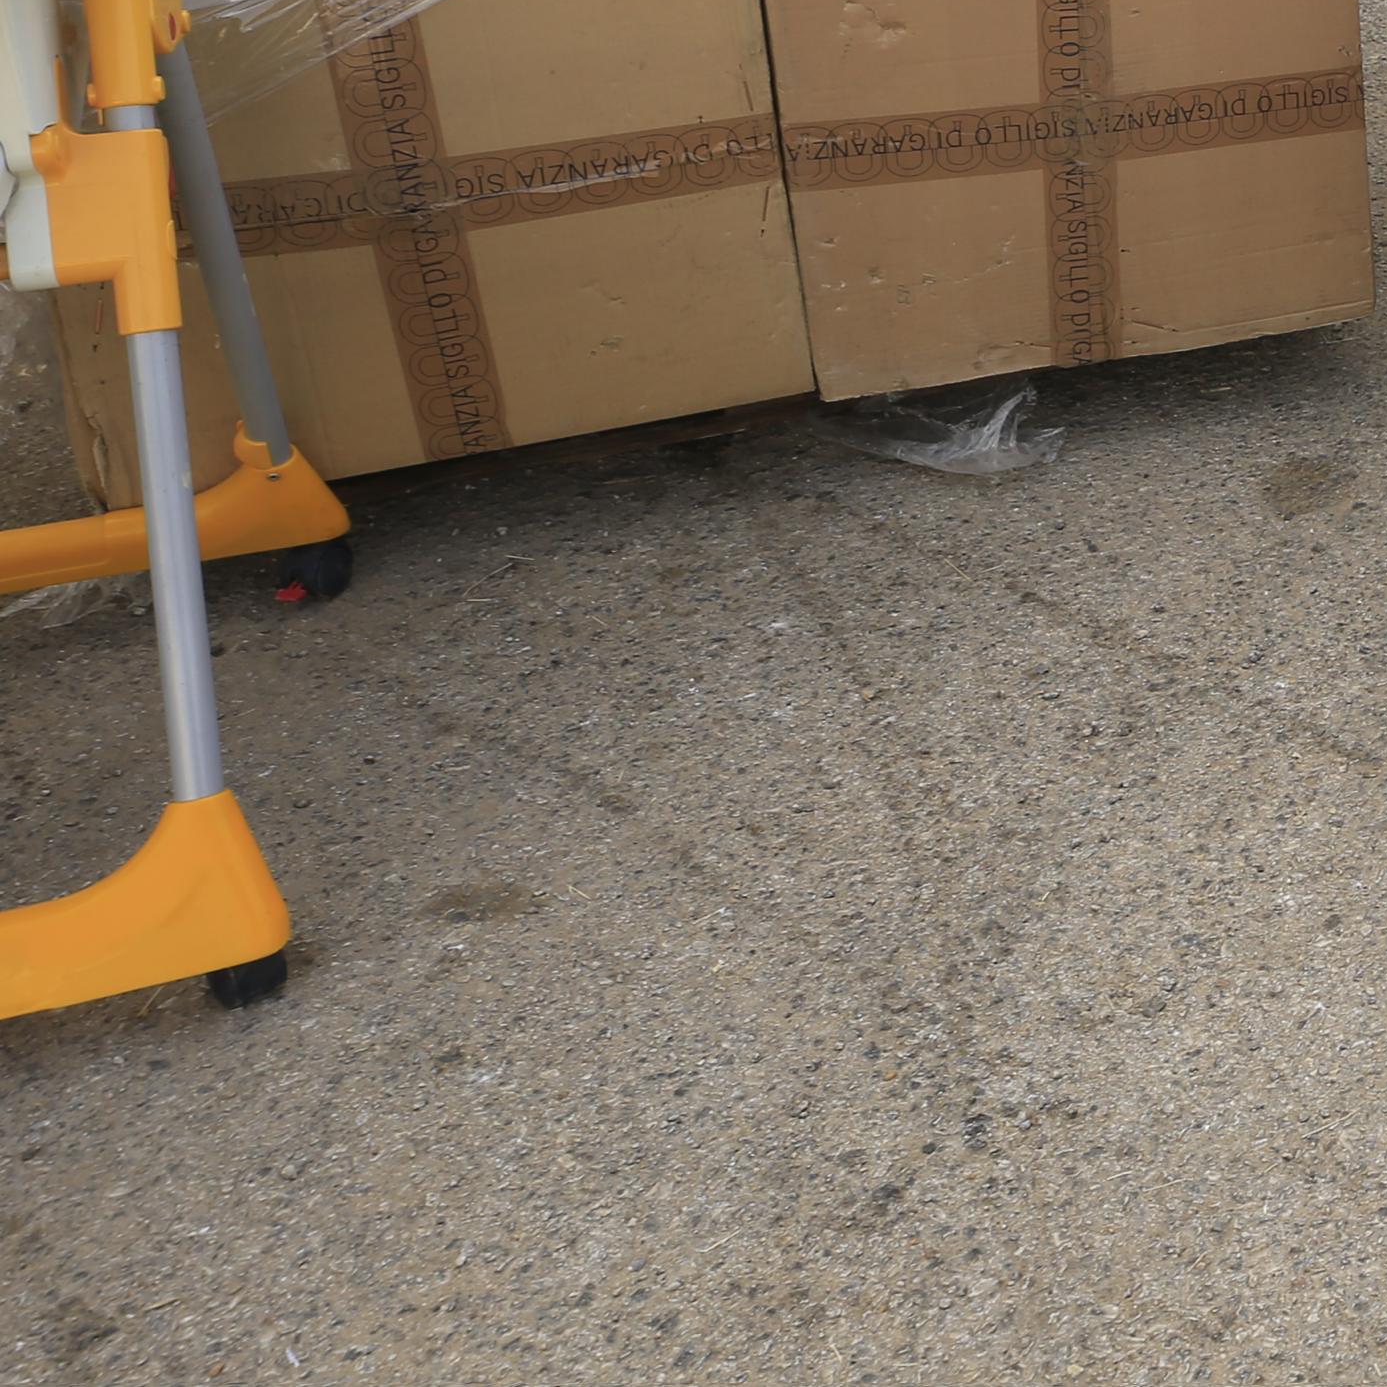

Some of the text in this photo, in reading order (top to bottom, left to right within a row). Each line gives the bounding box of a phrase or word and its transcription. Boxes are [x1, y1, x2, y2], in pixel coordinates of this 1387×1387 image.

[1061, 67, 1081, 89] DI
[1222, 98, 1247, 117] DI
[1257, 85, 1349, 114] SIGILLO
[938, 130, 962, 149] DI
[975, 119, 1076, 145] SIGILLO
[387, 117, 439, 253] GARANZIA
[420, 261, 448, 284] DI
[1068, 220, 1090, 304] SIGILLO
[1071, 312, 1091, 335] DI
[428, 293, 470, 380] SIGILLO
